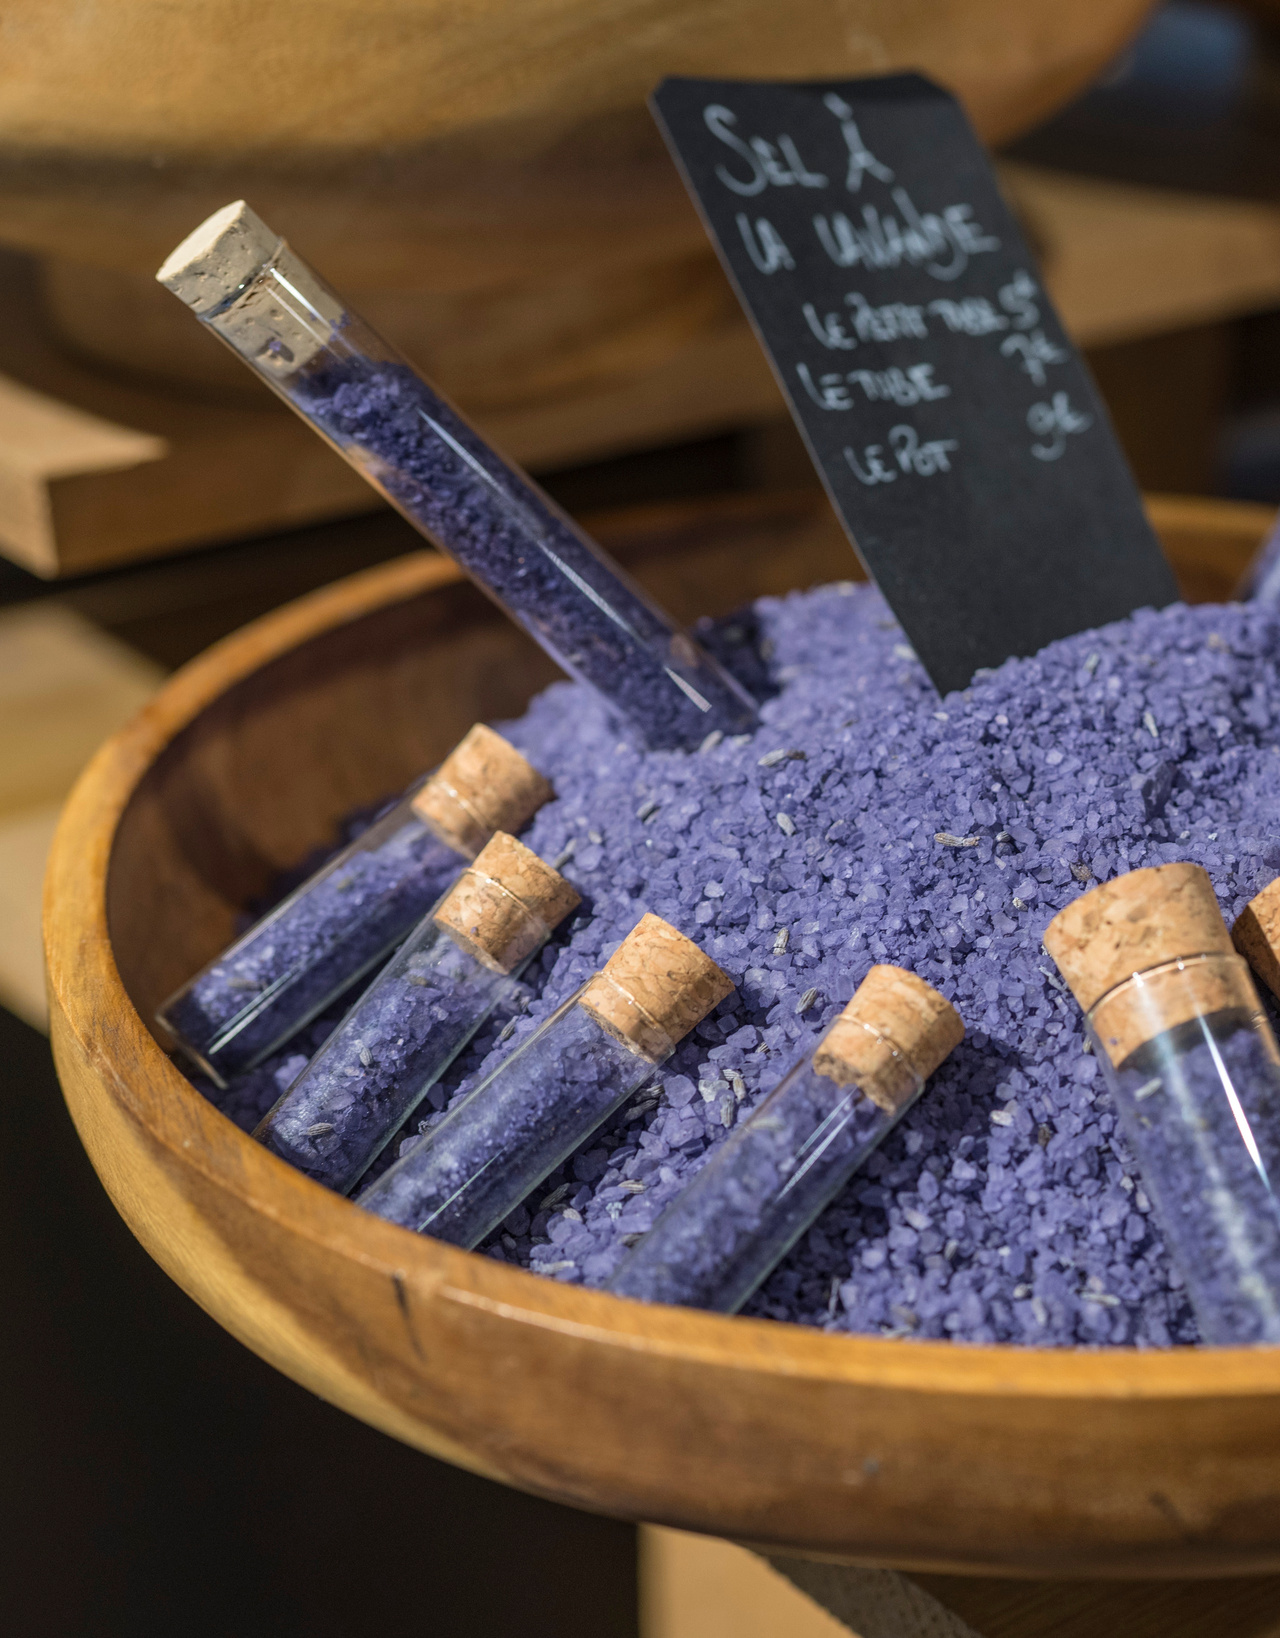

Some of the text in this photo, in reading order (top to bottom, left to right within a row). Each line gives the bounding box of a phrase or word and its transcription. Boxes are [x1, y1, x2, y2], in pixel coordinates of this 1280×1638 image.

[703, 103, 829, 197] SEL
[735, 211, 797, 276] LA
[802, 302, 858, 351] LE
[796, 361, 854, 411] LE
[846, 361, 951, 407] TUBE
[843, 443, 898, 486] LE
[887, 424, 961, 477] POT
